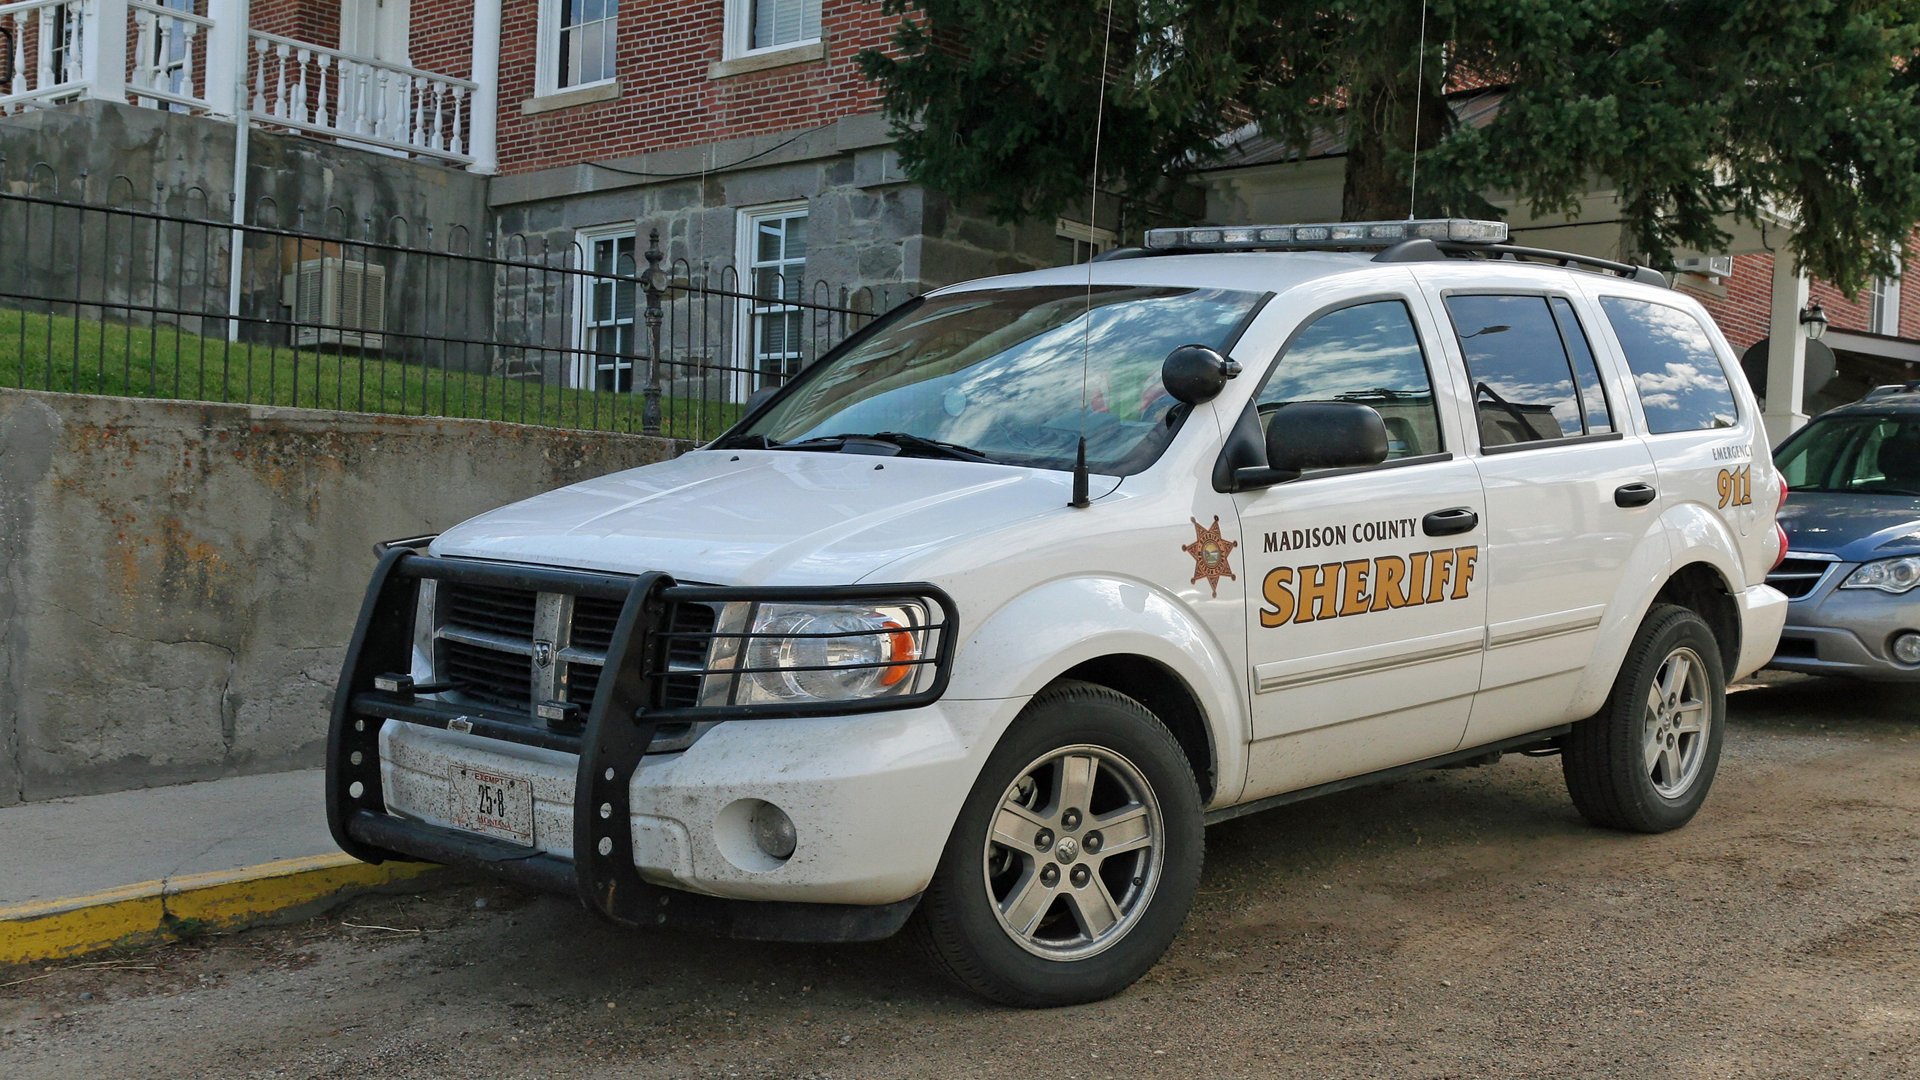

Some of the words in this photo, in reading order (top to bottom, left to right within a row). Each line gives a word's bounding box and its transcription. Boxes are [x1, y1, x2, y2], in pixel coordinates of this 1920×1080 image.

[1712, 444, 1753, 461] EMERGENCY
[1717, 464, 1752, 509] 911
[1263, 525, 1346, 553] MADISON
[1352, 518, 1417, 543] COUNTY
[1260, 545, 1479, 629] SHERIFF
[474, 773, 505, 785] EXEMPT
[476, 815, 513, 831] MONTANA
